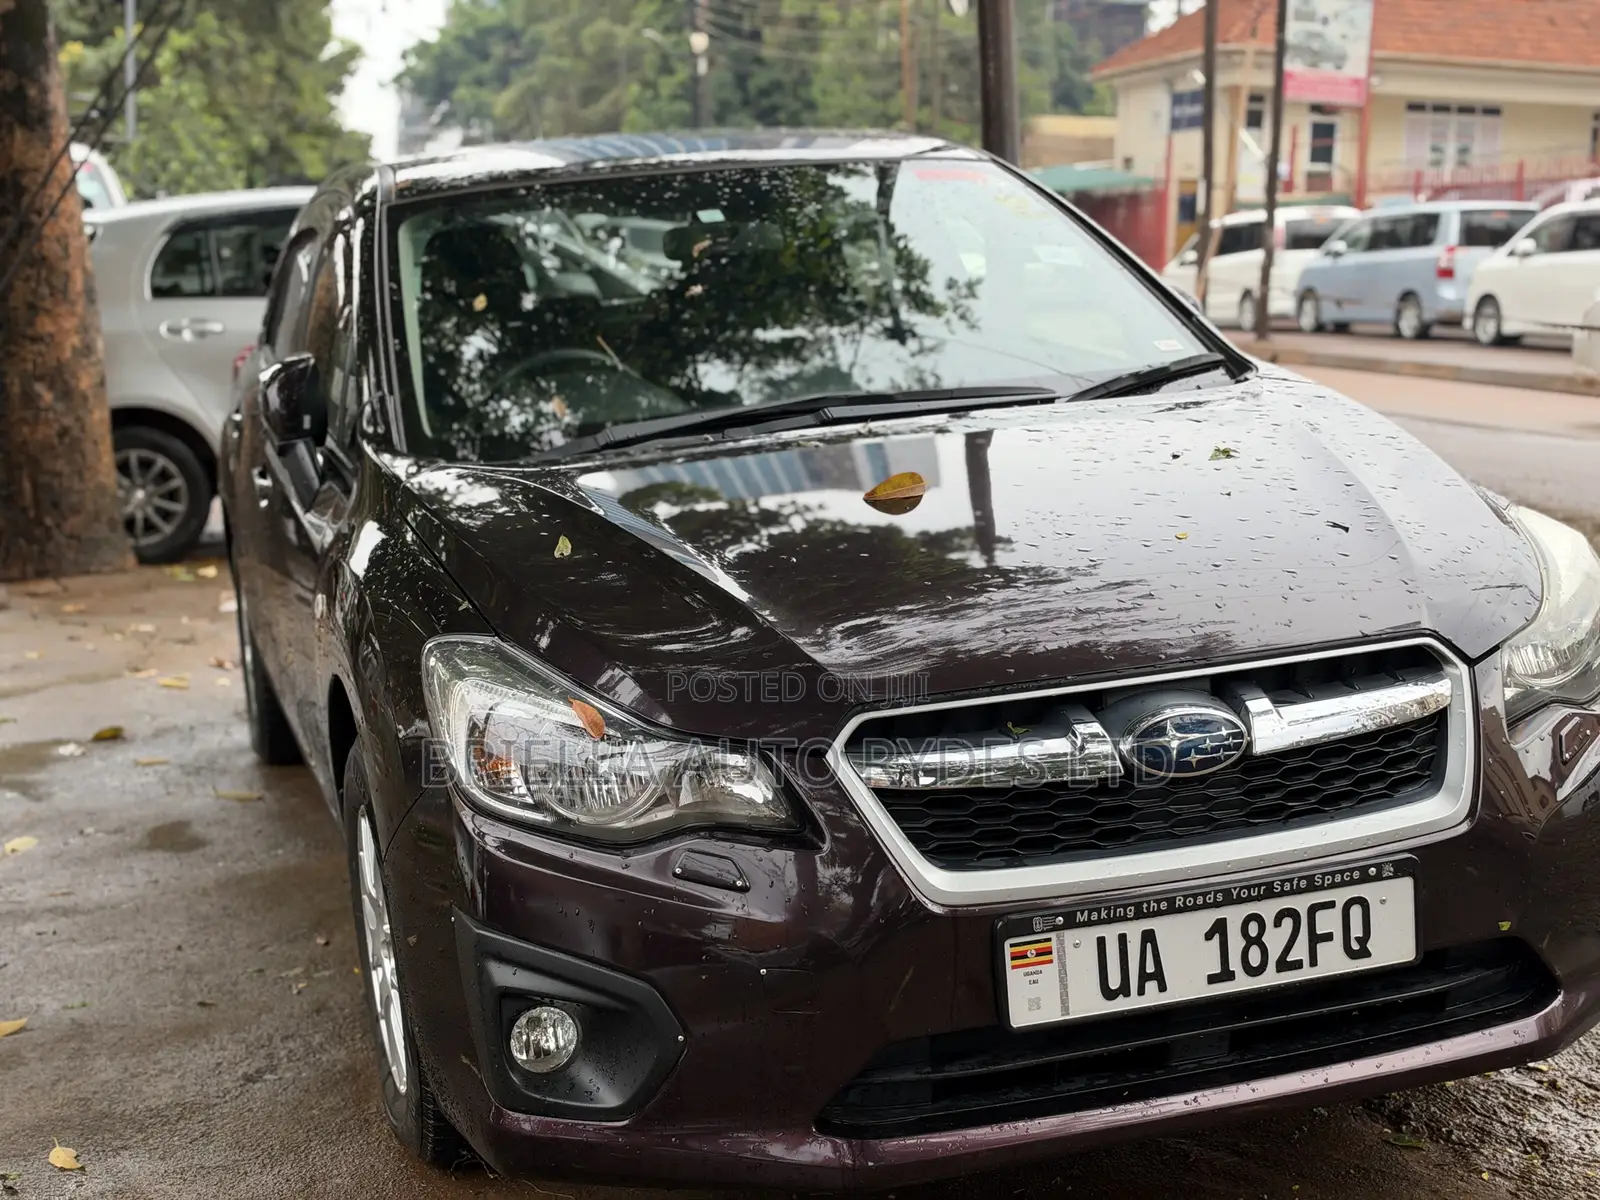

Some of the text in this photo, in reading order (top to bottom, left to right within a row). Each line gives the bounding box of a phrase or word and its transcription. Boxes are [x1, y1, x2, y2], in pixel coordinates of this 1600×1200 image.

[1075, 906, 1136, 923] Making
[1142, 901, 1168, 913] the
[1175, 891, 1224, 908] Roads
[1231, 885, 1266, 900] Your
[1273, 878, 1307, 893] Safe
[1314, 870, 1361, 887] Space
[1023, 969, 1043, 977] UGANDA
[1096, 895, 1374, 1001] UA 182FQ
